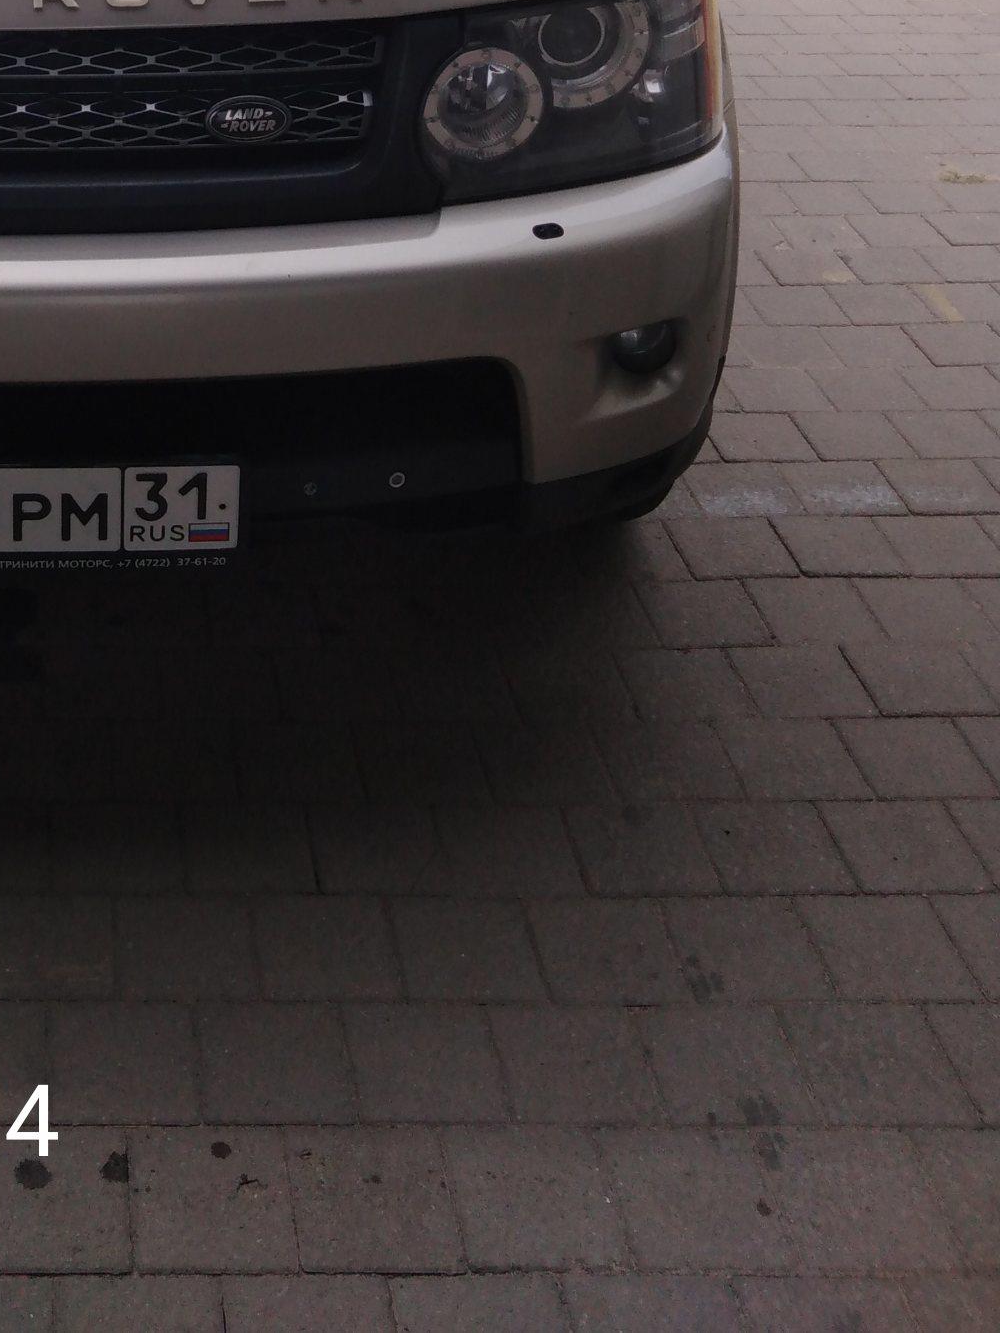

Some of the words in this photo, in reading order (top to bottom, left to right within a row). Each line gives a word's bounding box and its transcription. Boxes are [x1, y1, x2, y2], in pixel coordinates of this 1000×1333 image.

[225, 107, 264, 121] LAND
[228, 119, 277, 133] ROVER
[135, 472, 208, 522] 31
[129, 524, 185, 542] RUS
